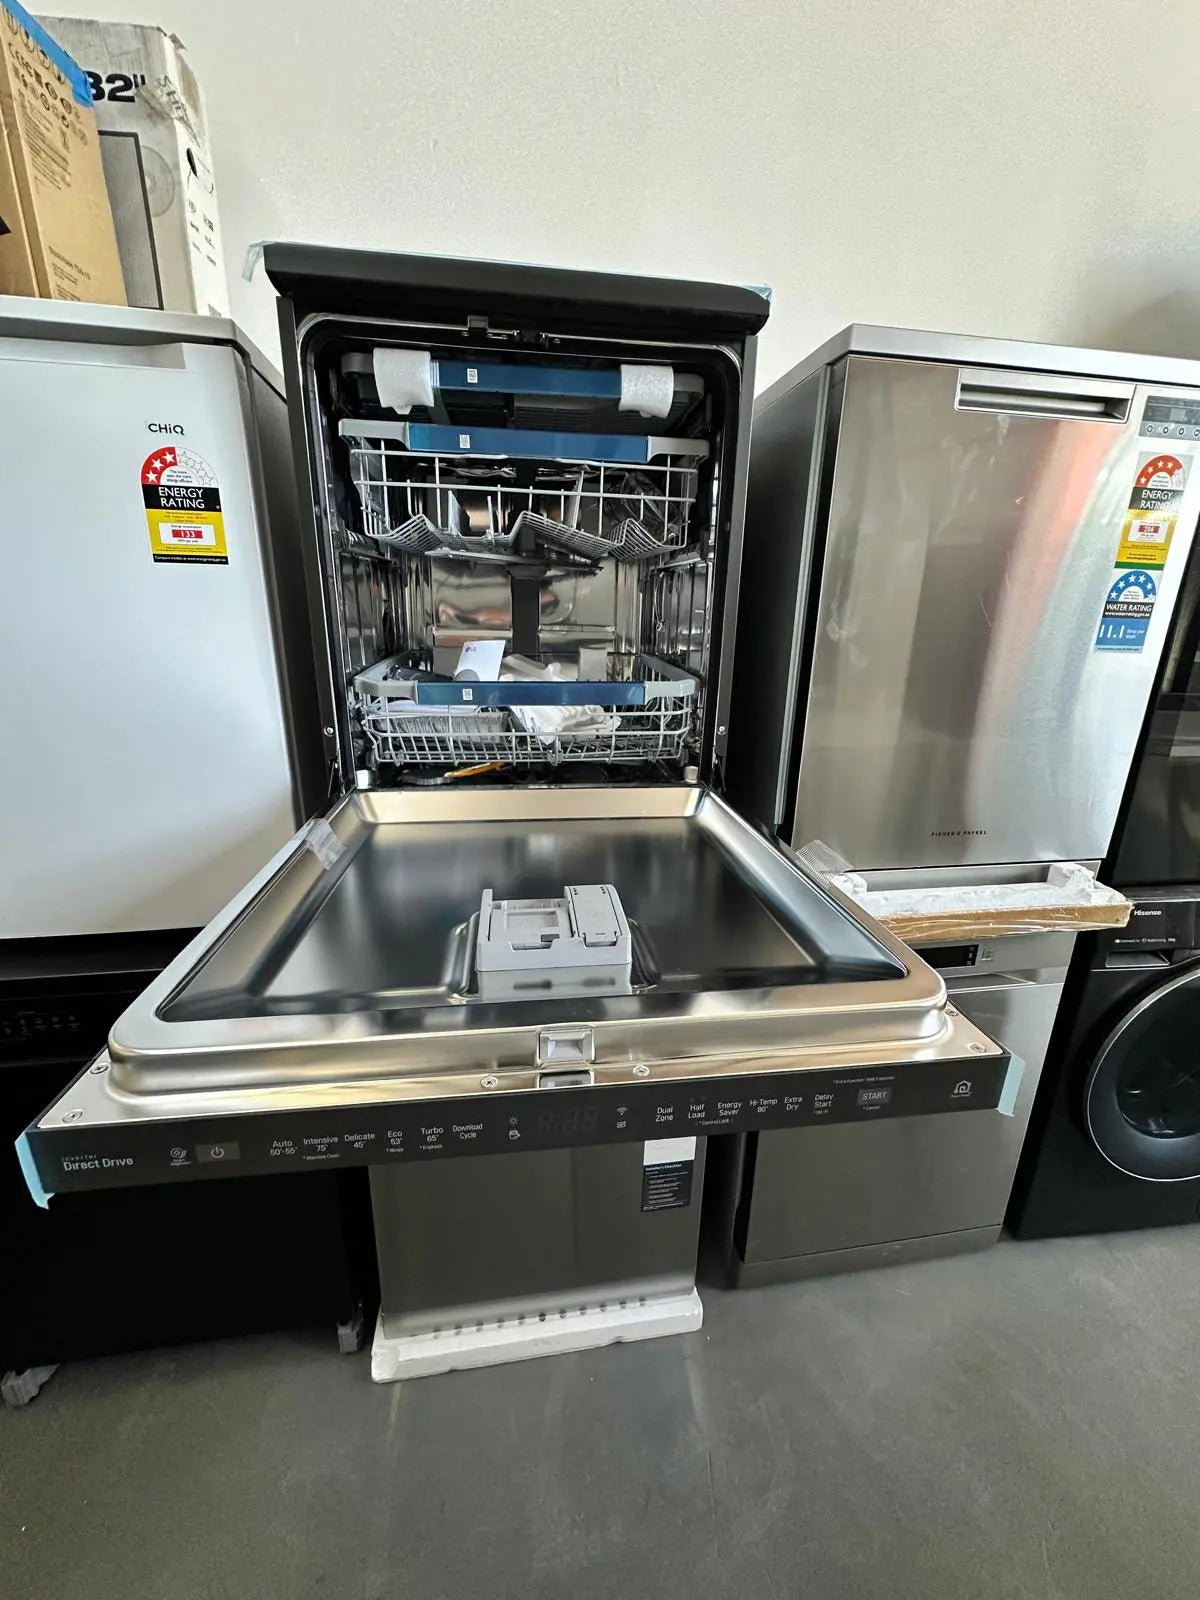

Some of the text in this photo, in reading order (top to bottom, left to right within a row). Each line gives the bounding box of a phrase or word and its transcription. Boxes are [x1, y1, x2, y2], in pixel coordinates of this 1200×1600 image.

[148, 423, 185, 436] CHiQ
[159, 486, 204, 498] ENERGY
[1141, 489, 1174, 500] ENERGY
[160, 497, 205, 509] RATING
[1140, 500, 1169, 511] RATING
[180, 530, 196, 538] 133
[1106, 603, 1153, 612] WATER RATING
[1099, 624, 1125, 639] 11.1
[862, 1091, 887, 1101] START
[717, 1102, 743, 1110] Energy
[749, 1099, 778, 1107] Hi-Temp
[786, 1103, 799, 1112] Dry
[657, 1106, 674, 1115] Dual
[688, 1111, 706, 1119] Load
[718, 1109, 740, 1117] Saver
[655, 1114, 674, 1122] Zone
[420, 1127, 444, 1135] Turbo
[452, 1123, 483, 1132] Download
[344, 1132, 375, 1142] Delicate
[387, 1130, 403, 1138] Eco
[459, 1131, 477, 1140] Cycle
[272, 1140, 293, 1148] Auto
[303, 1136, 339, 1145] Intensive
[63, 1156, 134, 1172] Direct Drive
